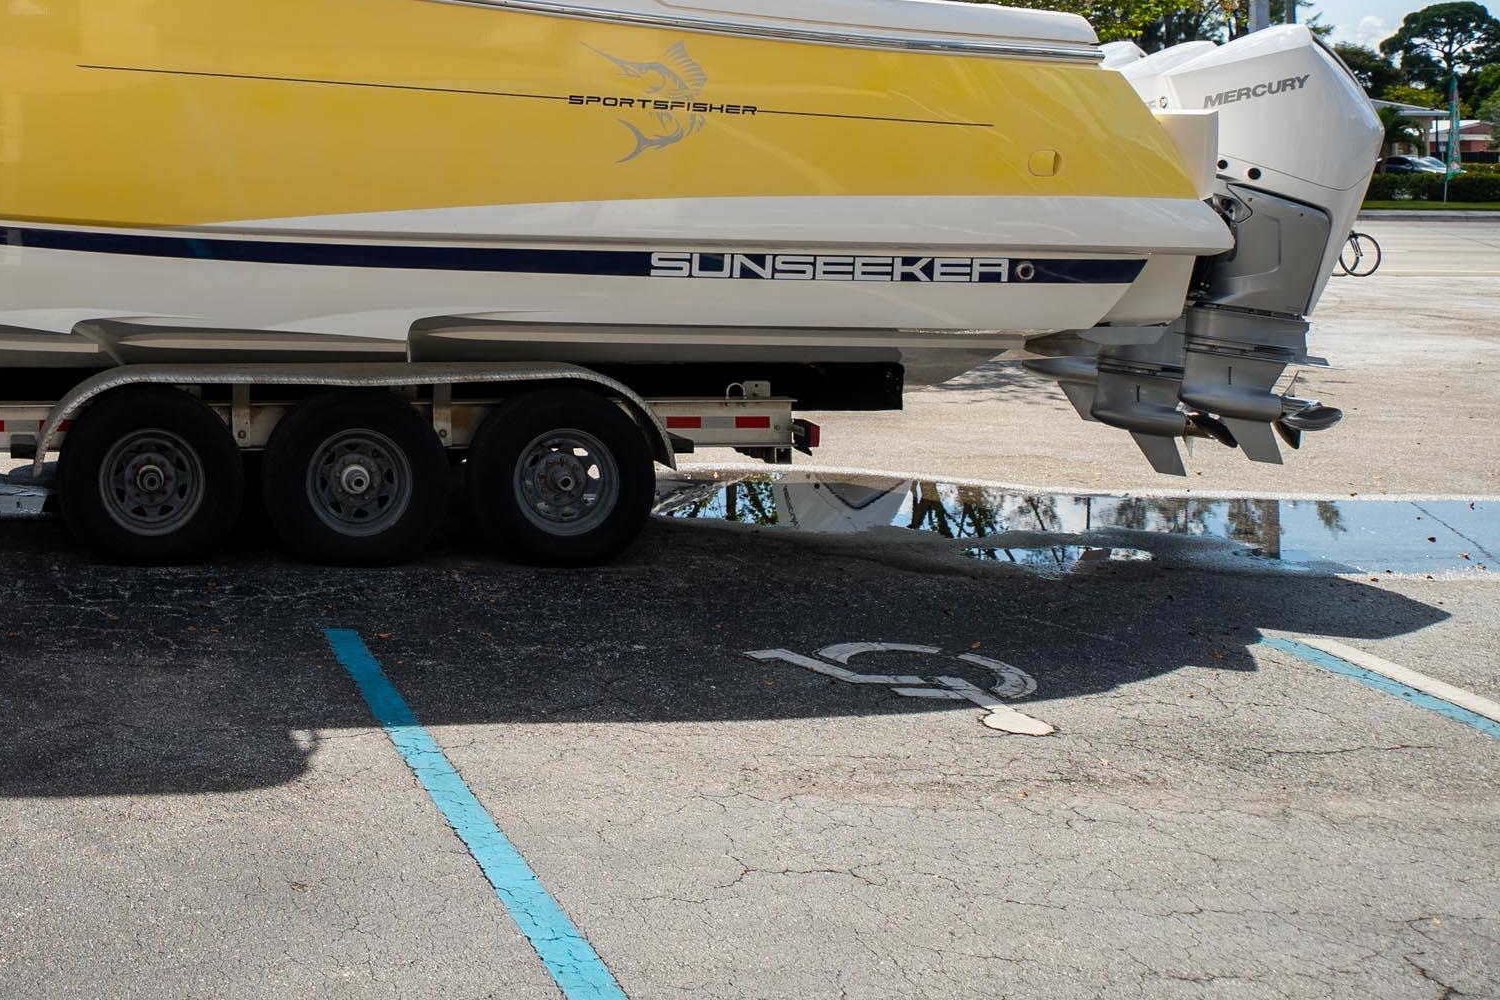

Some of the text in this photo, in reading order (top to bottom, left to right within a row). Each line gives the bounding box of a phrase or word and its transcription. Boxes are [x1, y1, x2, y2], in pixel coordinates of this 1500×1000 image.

[568, 95, 758, 115] SPORTSFISHER
[1203, 74, 1311, 108] MERCURY
[650, 252, 1009, 282] SUNSEEKER
